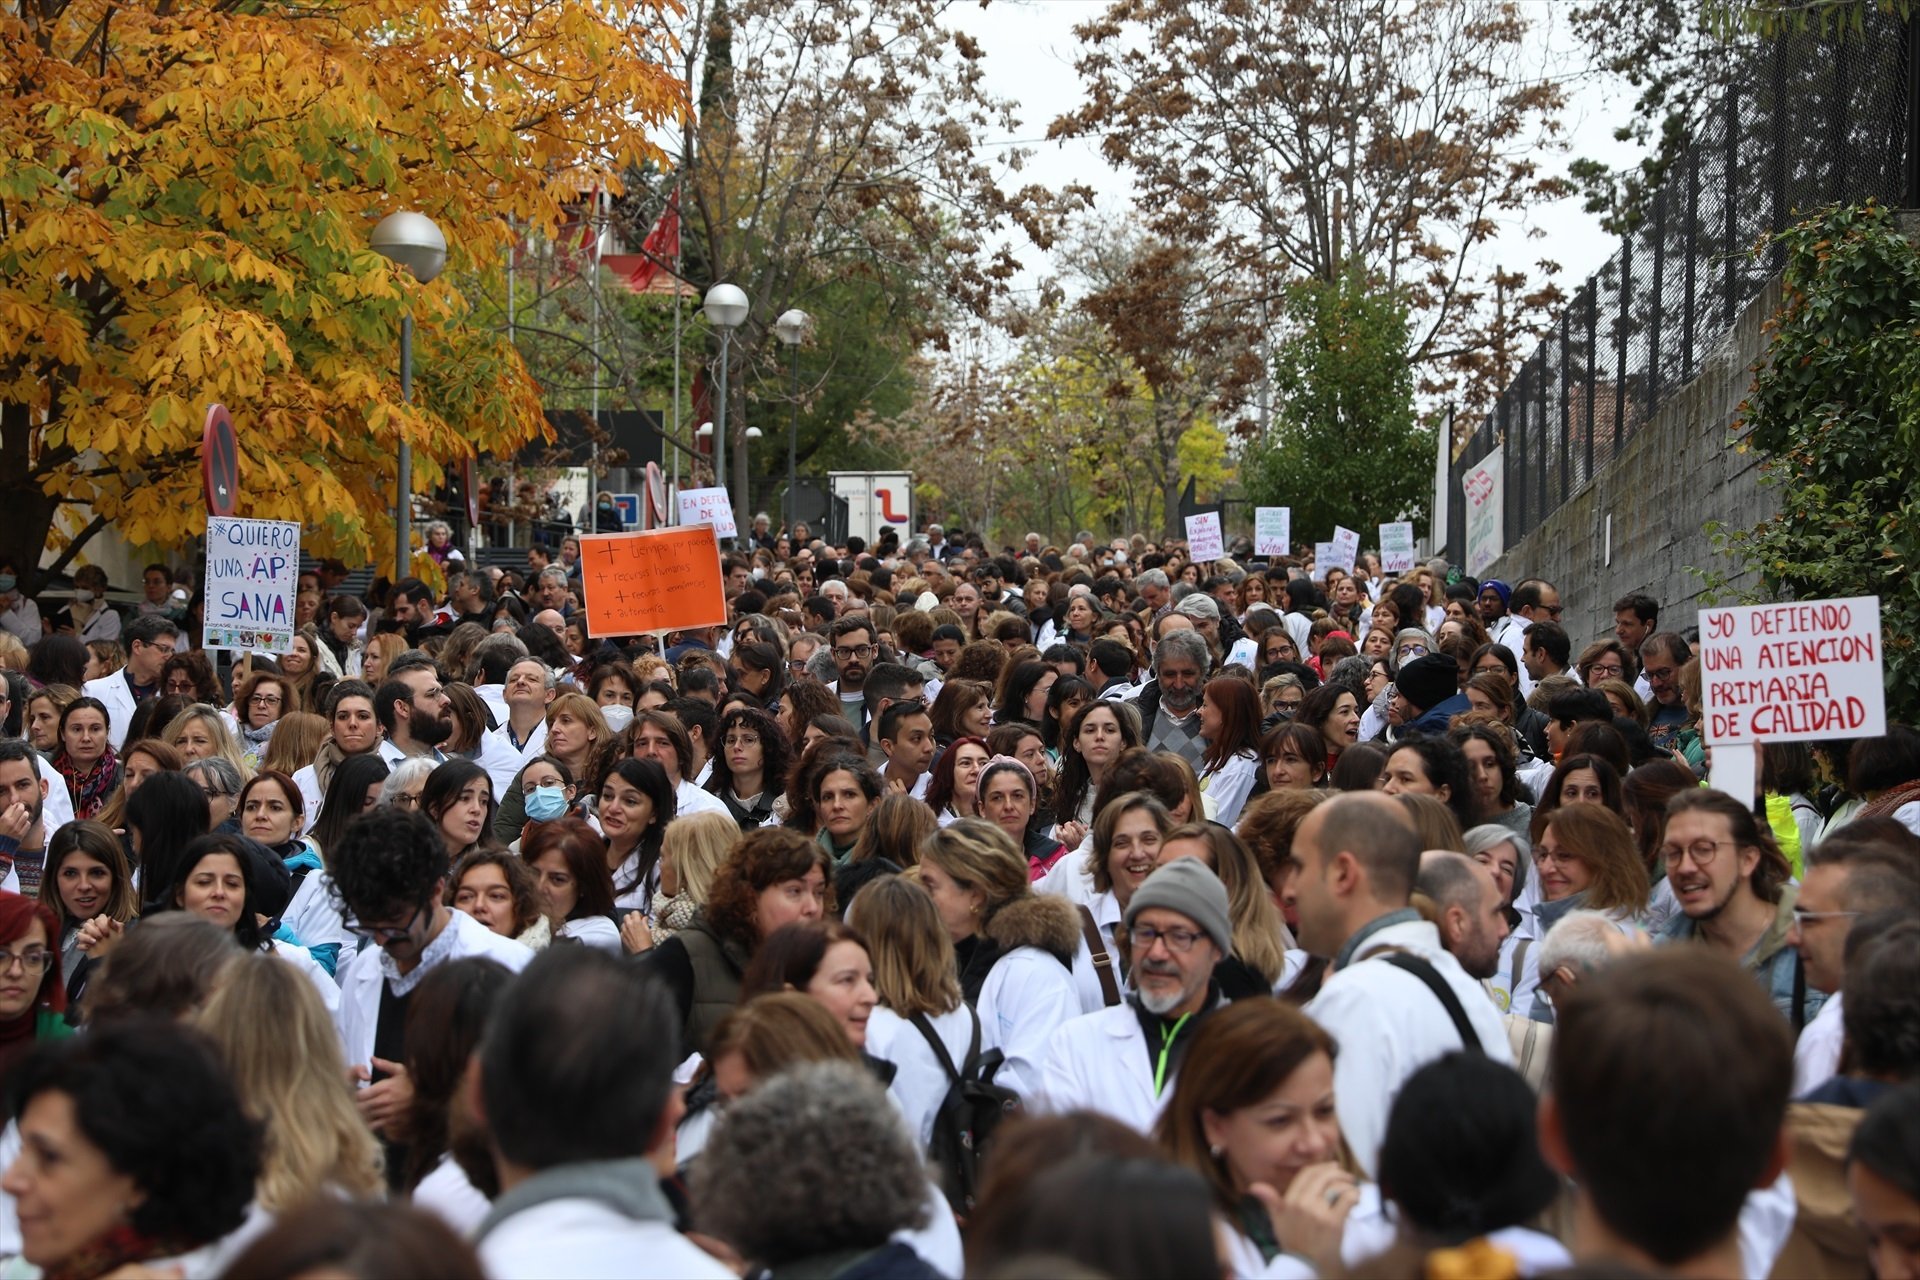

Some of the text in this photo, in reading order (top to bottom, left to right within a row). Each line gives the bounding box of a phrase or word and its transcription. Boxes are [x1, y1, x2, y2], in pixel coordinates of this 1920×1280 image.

[683, 497, 697, 509] EN
[701, 509, 713, 520] DE
[213, 523, 293, 549] #QUIERO
[716, 522, 735, 532] LUD
[630, 539, 669, 560] tiempo
[214, 557, 244, 578] UNA
[251, 556, 285, 579] AP
[221, 591, 286, 624] SANA
[1707, 605, 1851, 639] YO DEFIENDO
[1705, 633, 1874, 671] UNA ATENCION
[1711, 672, 1829, 707] PRIMARIA
[1712, 696, 1866, 738] DE CALIDAD
